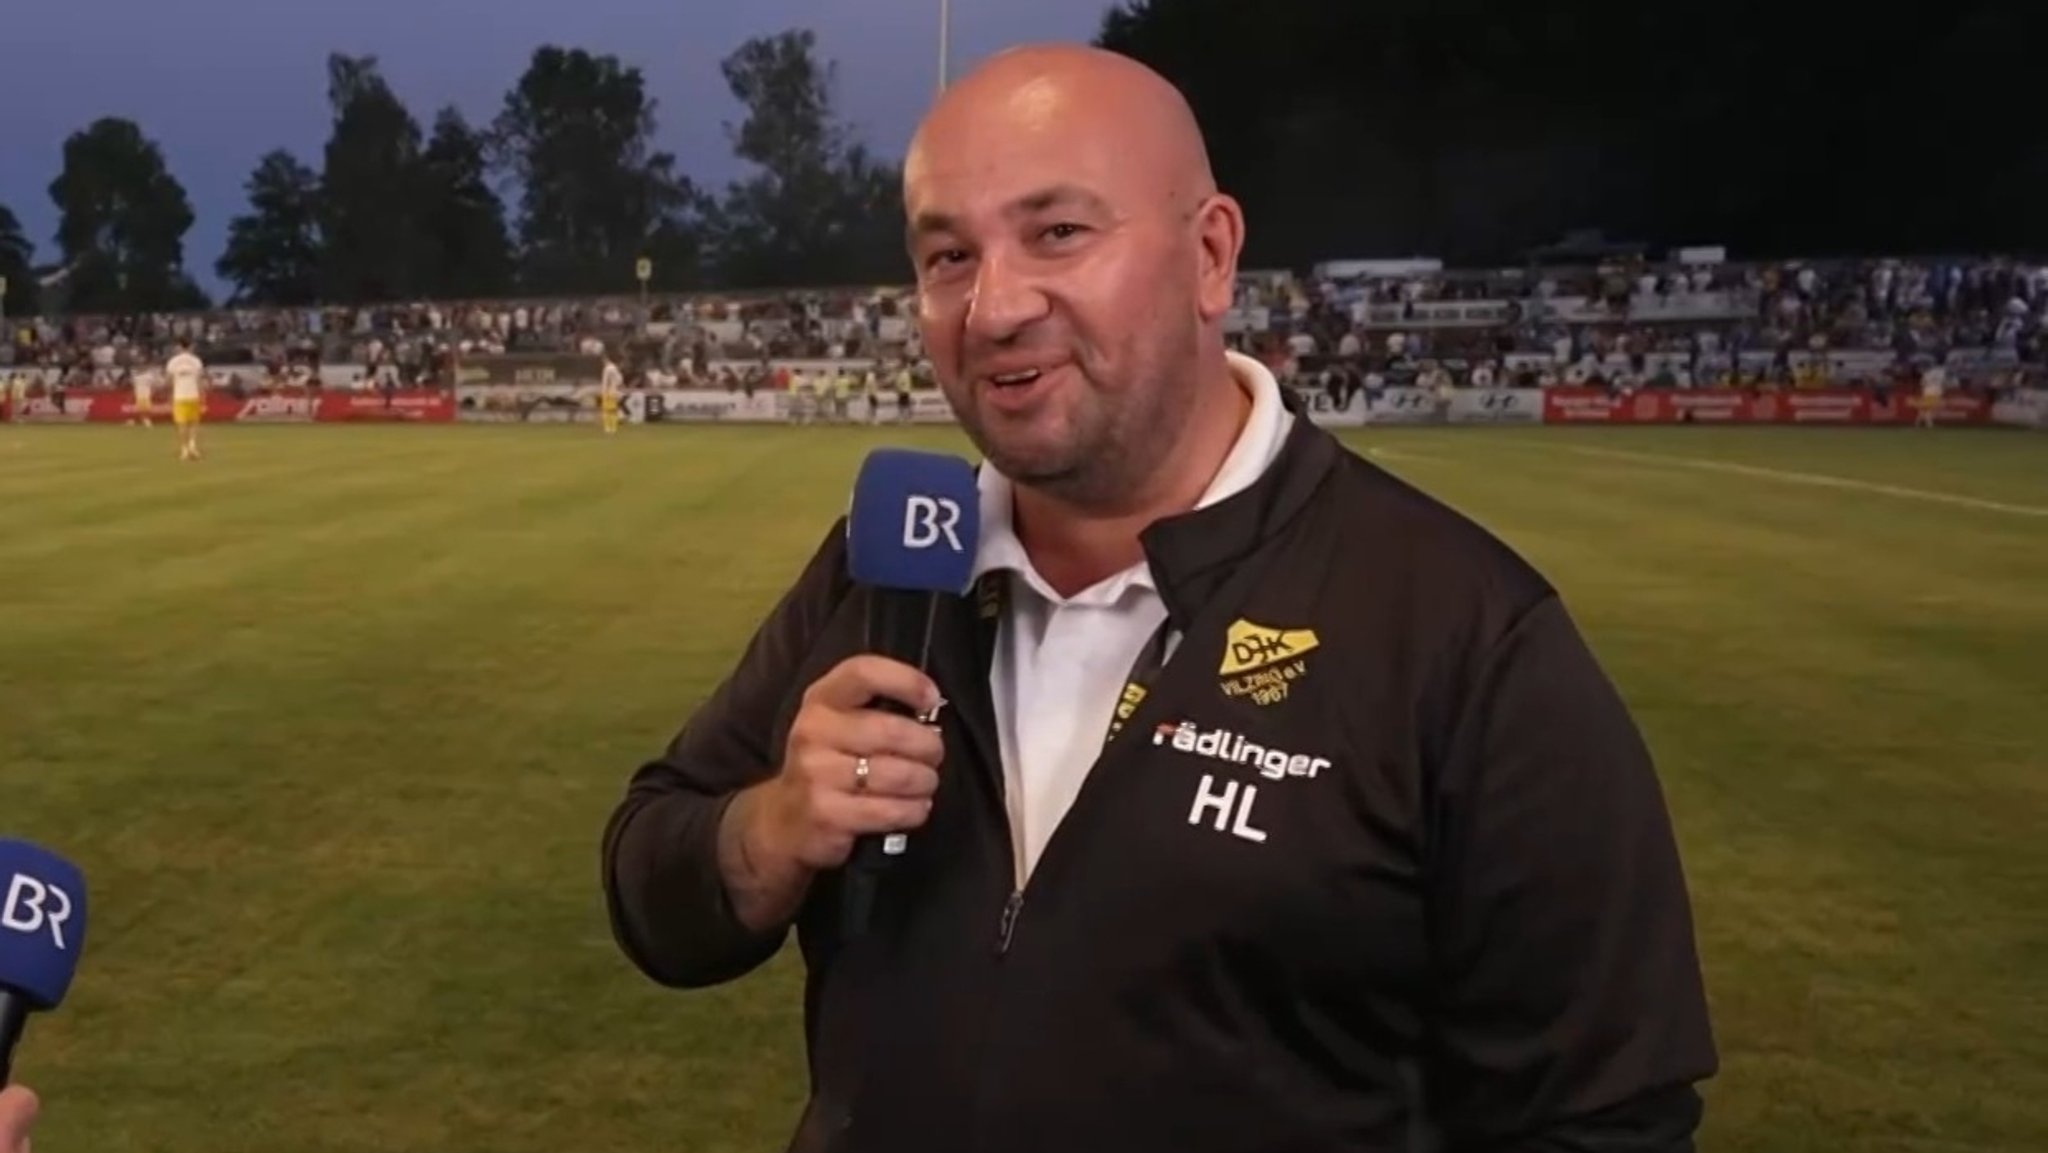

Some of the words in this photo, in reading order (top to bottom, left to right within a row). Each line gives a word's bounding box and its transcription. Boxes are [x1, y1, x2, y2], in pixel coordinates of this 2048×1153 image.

[903, 495, 963, 551] BR
[1231, 630, 1293, 666] DJK
[1152, 720, 1332, 781] rädlinger
[1188, 774, 1268, 843] HL
[2, 873, 71, 949] BR
